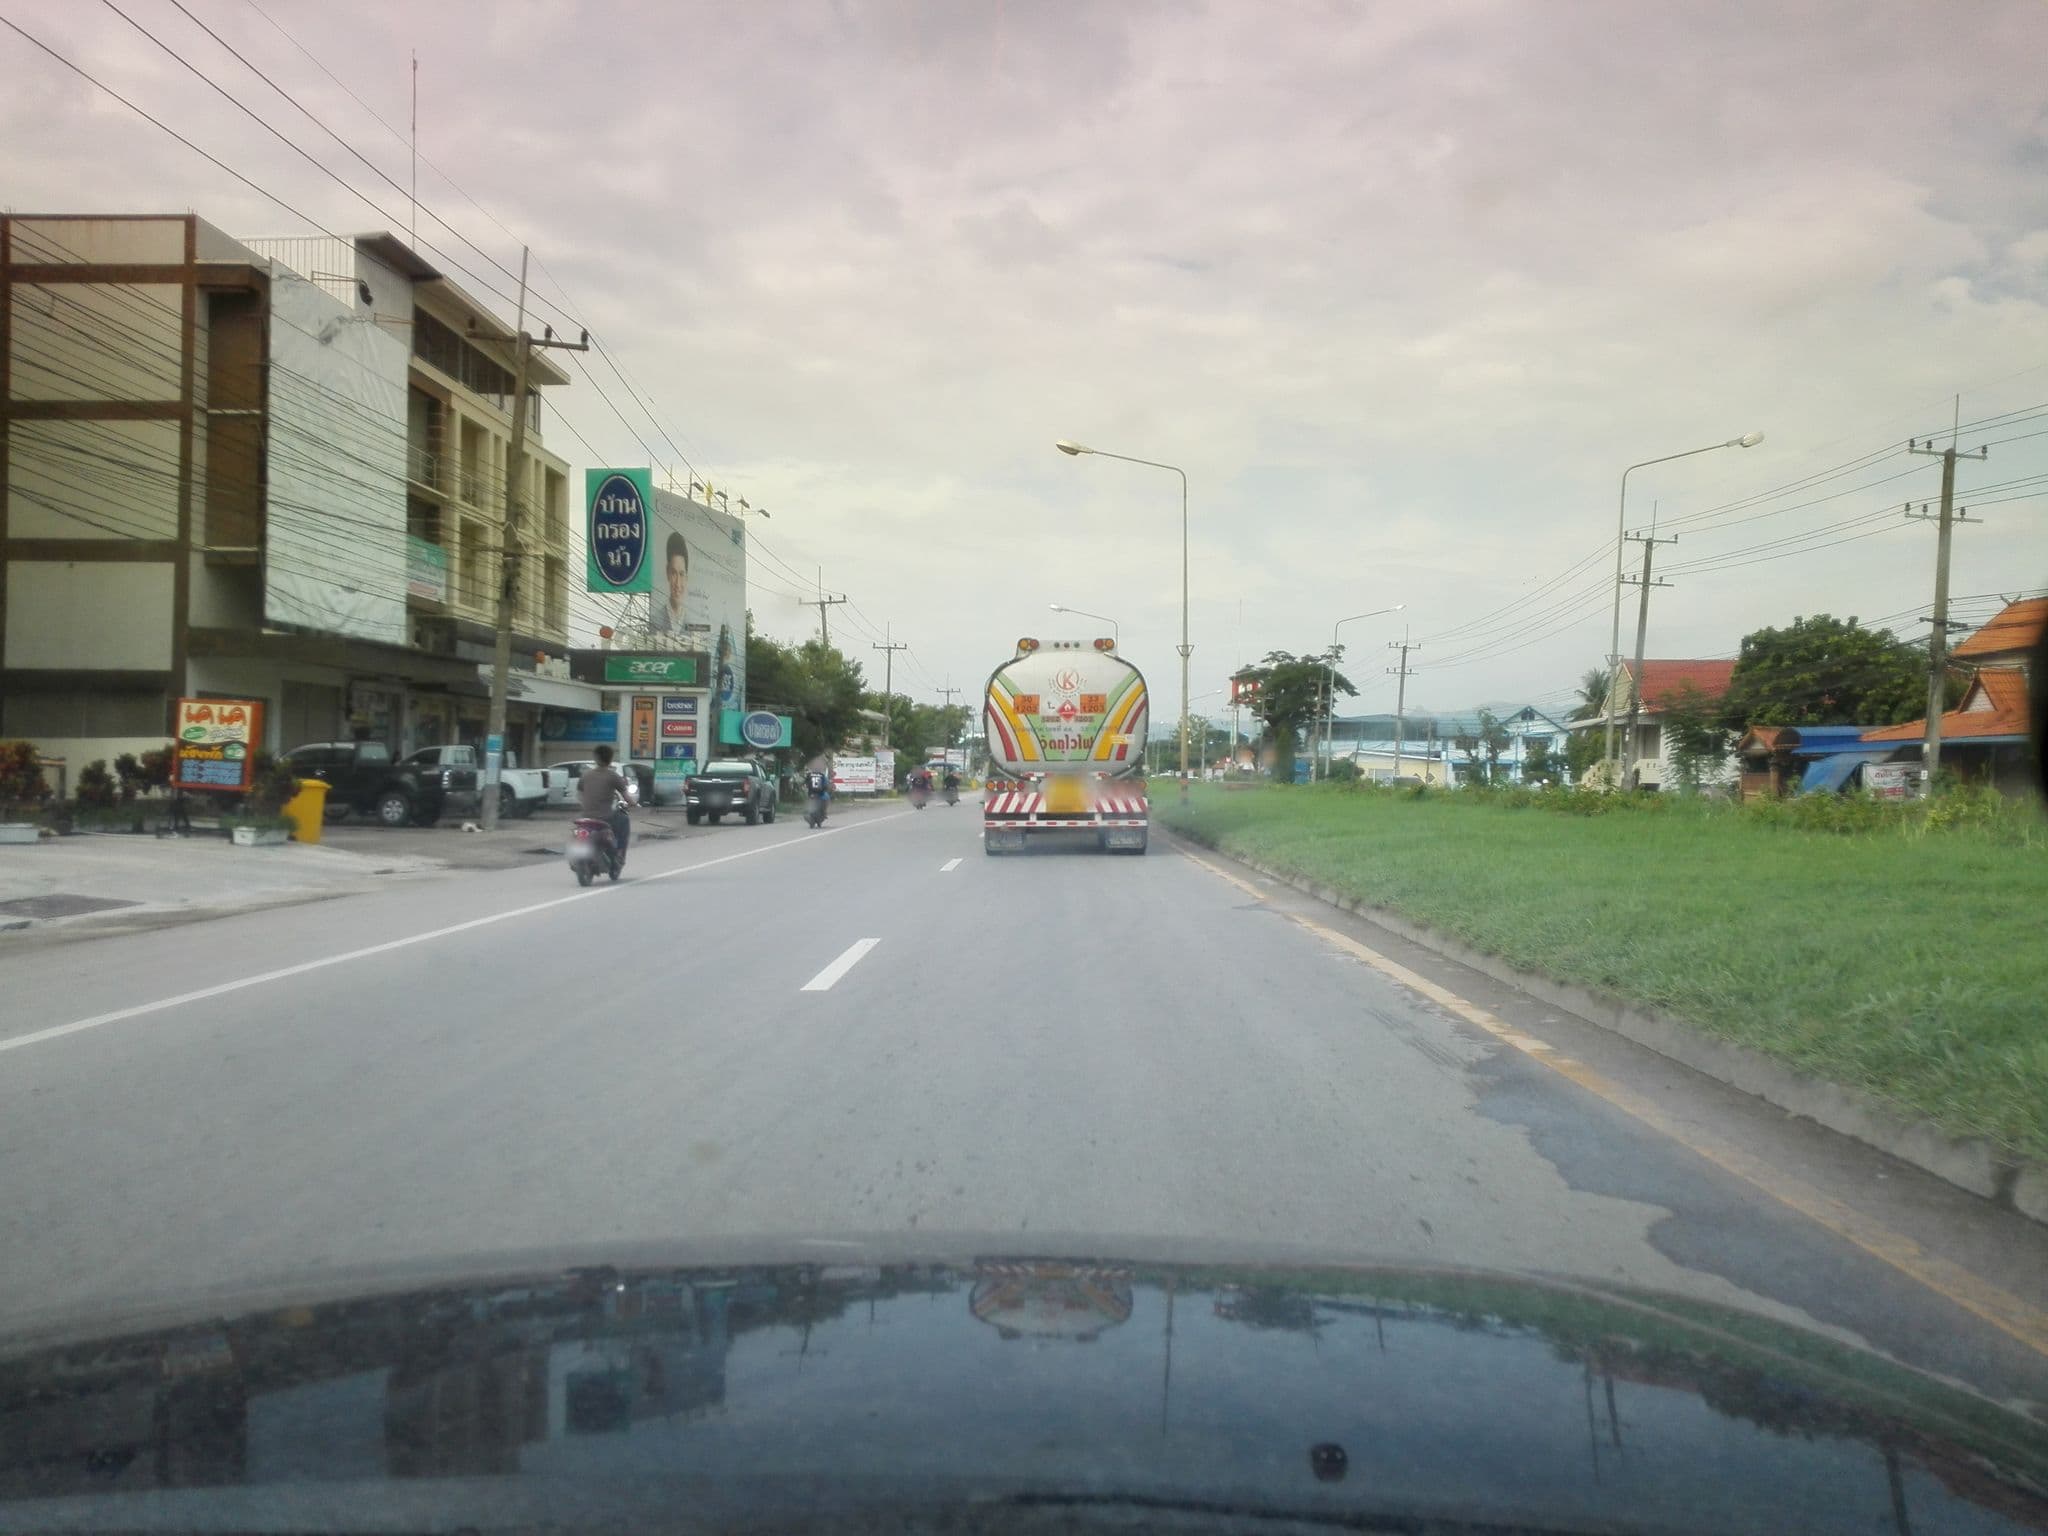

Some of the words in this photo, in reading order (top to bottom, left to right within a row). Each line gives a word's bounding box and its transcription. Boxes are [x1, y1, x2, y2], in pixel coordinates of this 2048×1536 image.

[599, 495, 638, 514] บ้าน
[598, 523, 640, 539] กรอง
[629, 661, 675, 674] acer
[667, 702, 694, 710] brother
[666, 724, 693, 732] Canon
